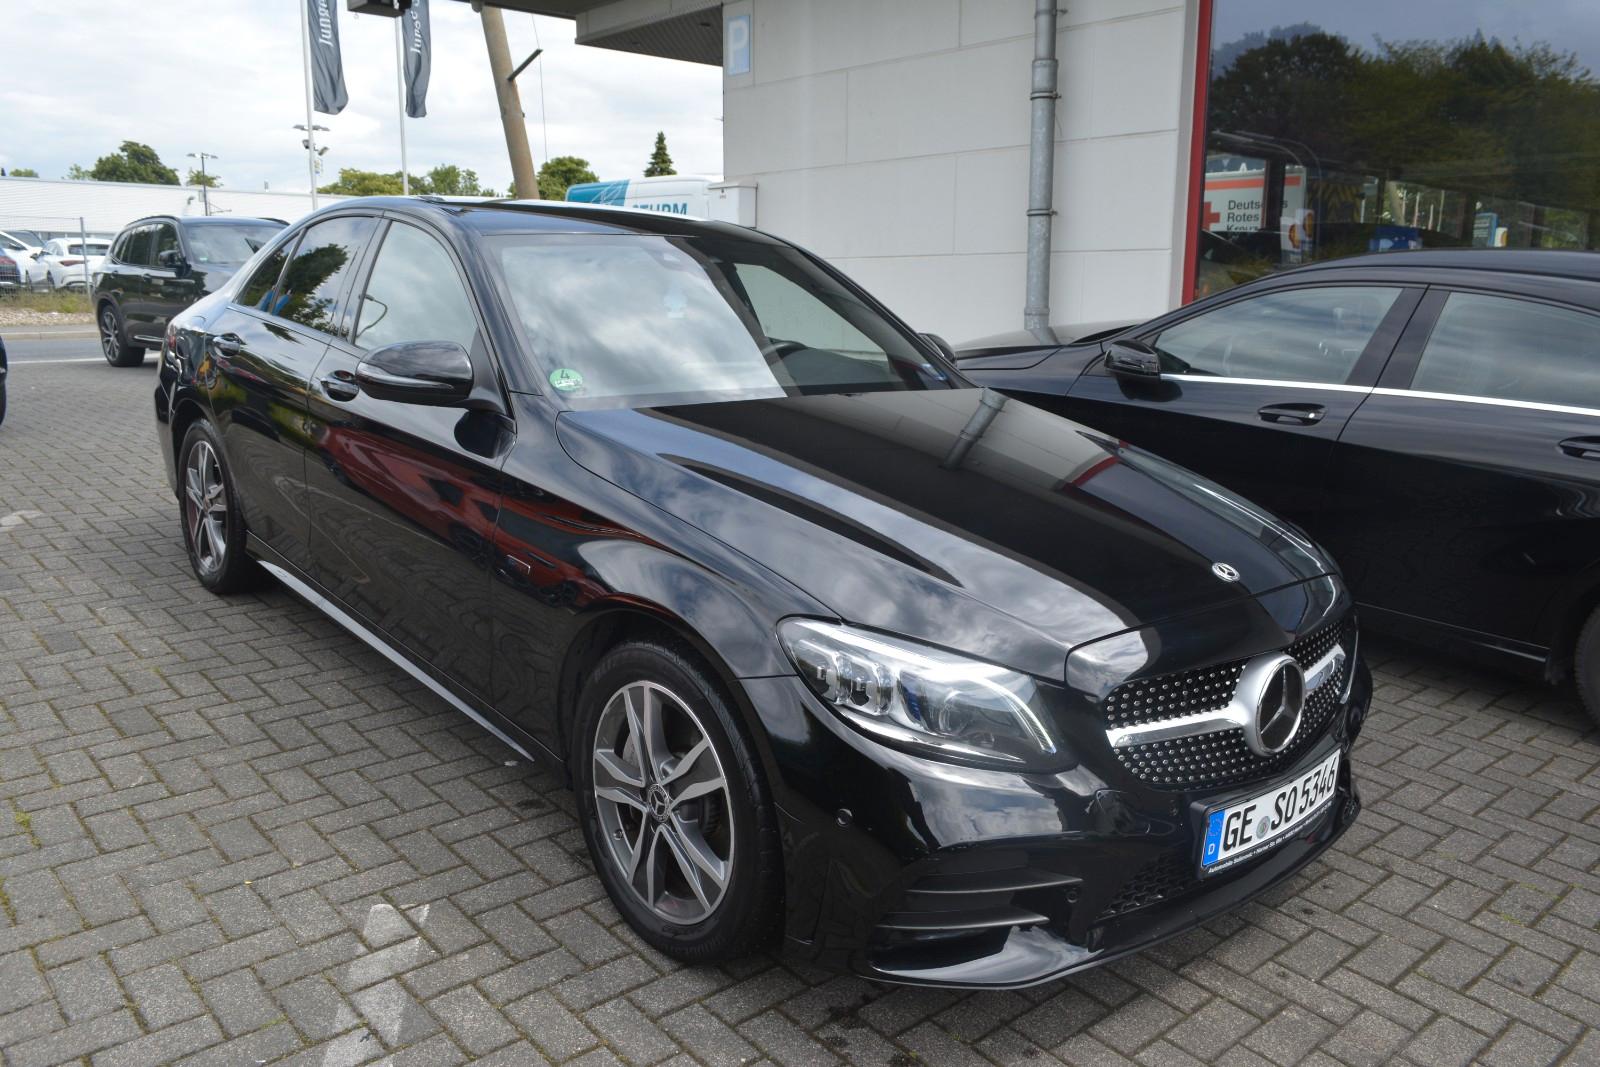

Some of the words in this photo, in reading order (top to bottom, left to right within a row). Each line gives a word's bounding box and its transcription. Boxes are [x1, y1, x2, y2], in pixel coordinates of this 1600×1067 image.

[728, 20, 748, 69] P
[632, 203, 687, 215] URM
[1227, 212, 1260, 222] Rotes
[1223, 804, 1257, 852] GE
[1299, 756, 1337, 814] 5346
[1208, 843, 1215, 855] D
